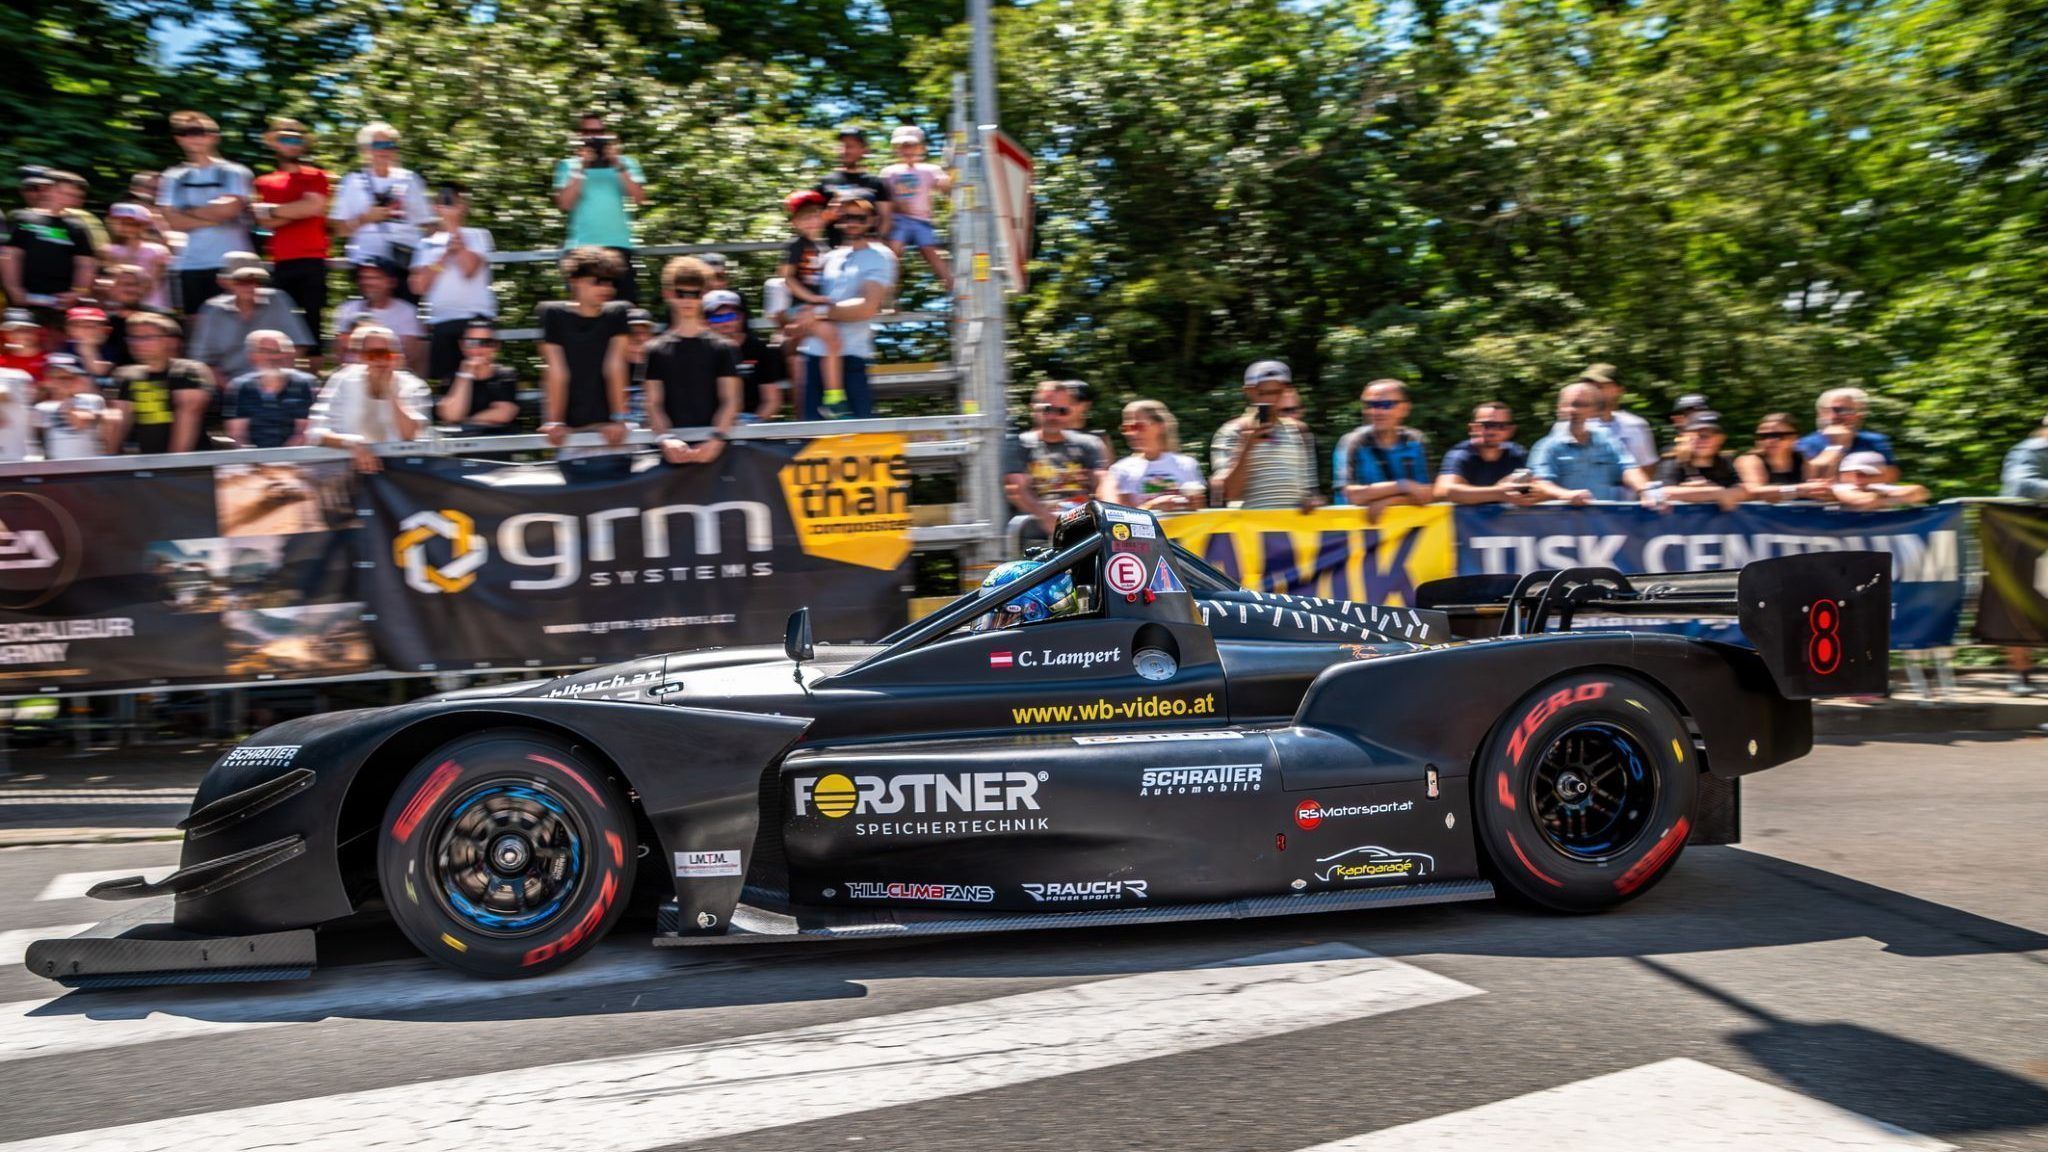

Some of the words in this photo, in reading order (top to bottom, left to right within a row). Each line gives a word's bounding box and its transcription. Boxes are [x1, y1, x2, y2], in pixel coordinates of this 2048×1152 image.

[793, 454, 914, 486] more
[801, 483, 911, 518] than
[496, 500, 773, 590] grm
[1470, 534, 1627, 575] TISK
[589, 562, 773, 586] SYSTEMS
[1118, 563, 1135, 584] E
[1168, 526, 1427, 607] AMK
[1809, 599, 1841, 674] 8
[1018, 650, 1038, 667] C.
[1041, 647, 1121, 669] Lampert
[1012, 692, 1215, 724] www.wb-video.at
[1505, 681, 1614, 767] ZERO
[227, 745, 302, 760] SCHRATTER
[1141, 764, 1262, 787] SCHRATTER
[1140, 783, 1261, 796] Automobile
[1298, 800, 1414, 820] RSMotorsport.at
[855, 817, 1049, 836] SPEICHERTECHNIK
[845, 882, 996, 902] HILLCLIMBFANS
[1046, 880, 1121, 895] RAUCH
